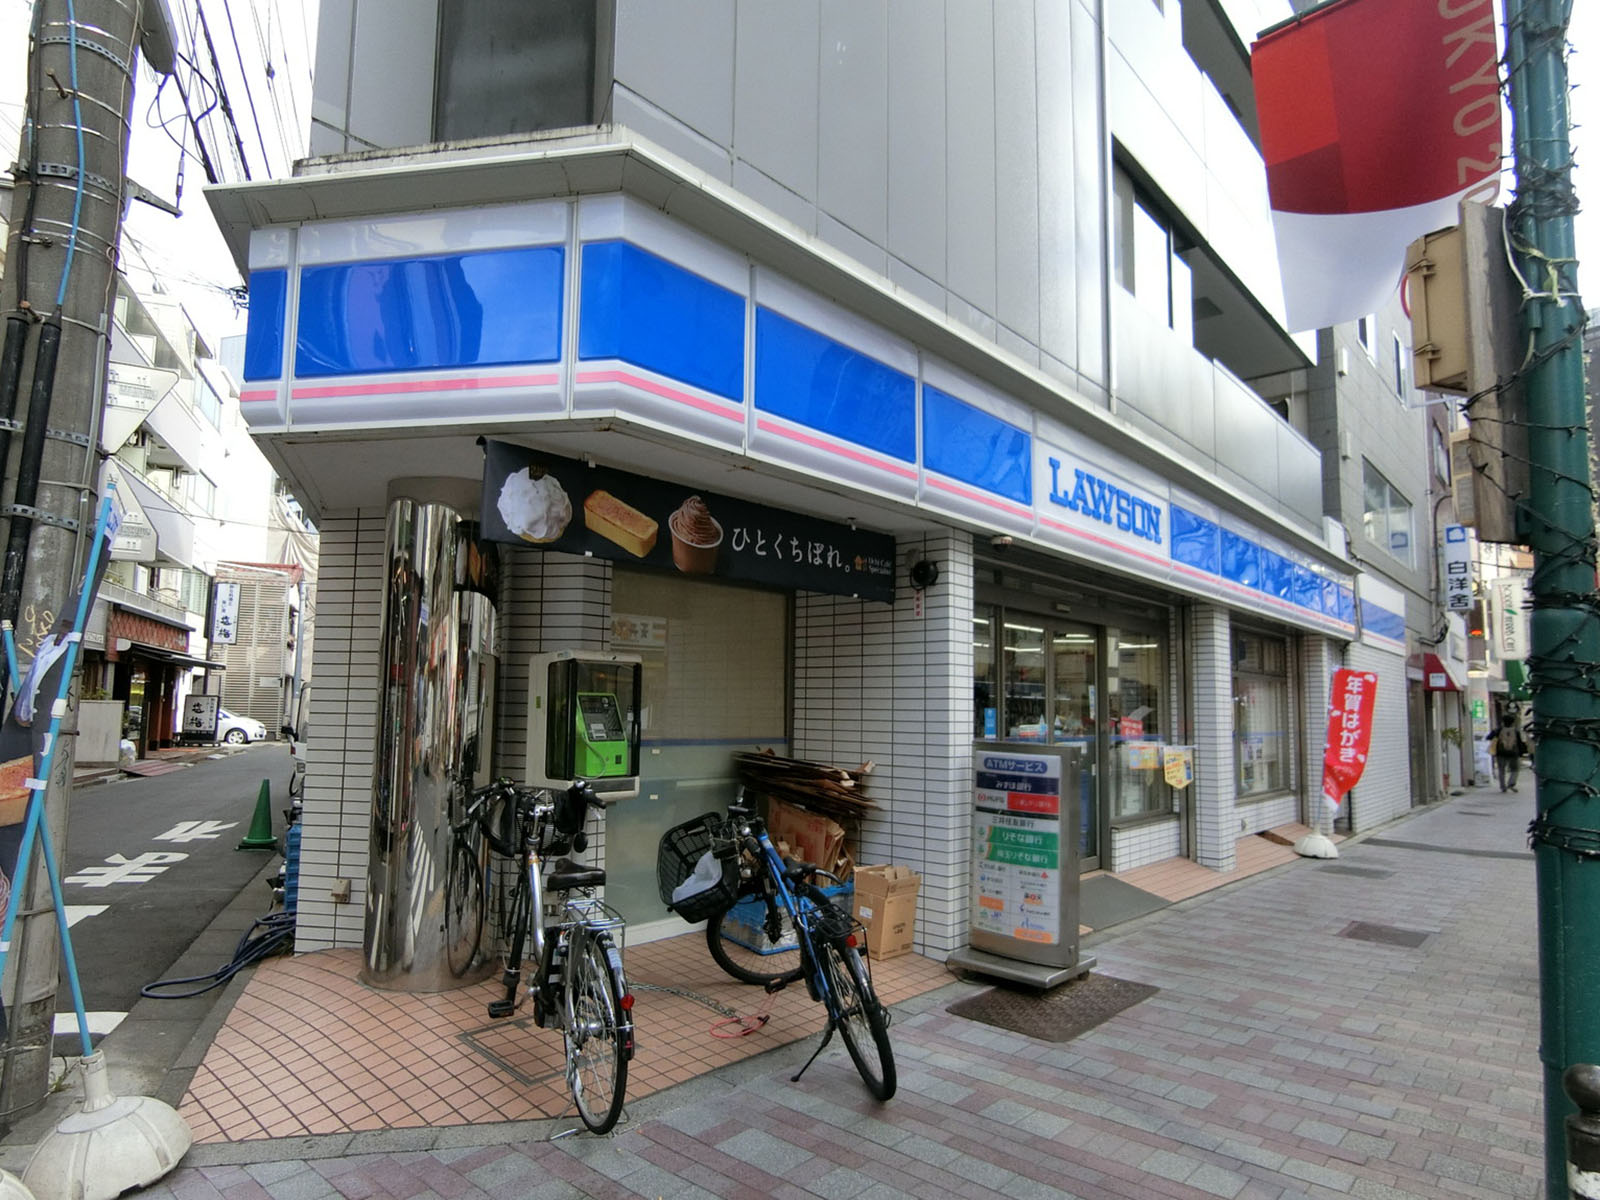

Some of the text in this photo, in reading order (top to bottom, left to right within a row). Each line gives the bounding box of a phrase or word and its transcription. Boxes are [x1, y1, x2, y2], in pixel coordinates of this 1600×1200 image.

[1048, 456, 1162, 545] LAWSON
[1339, 675, 1364, 763] 年賀はがき
[986, 759, 1044, 773] ATMサービス
[992, 815, 1034, 829] 三井住友銀行
[1002, 831, 1043, 845] りそな銀行
